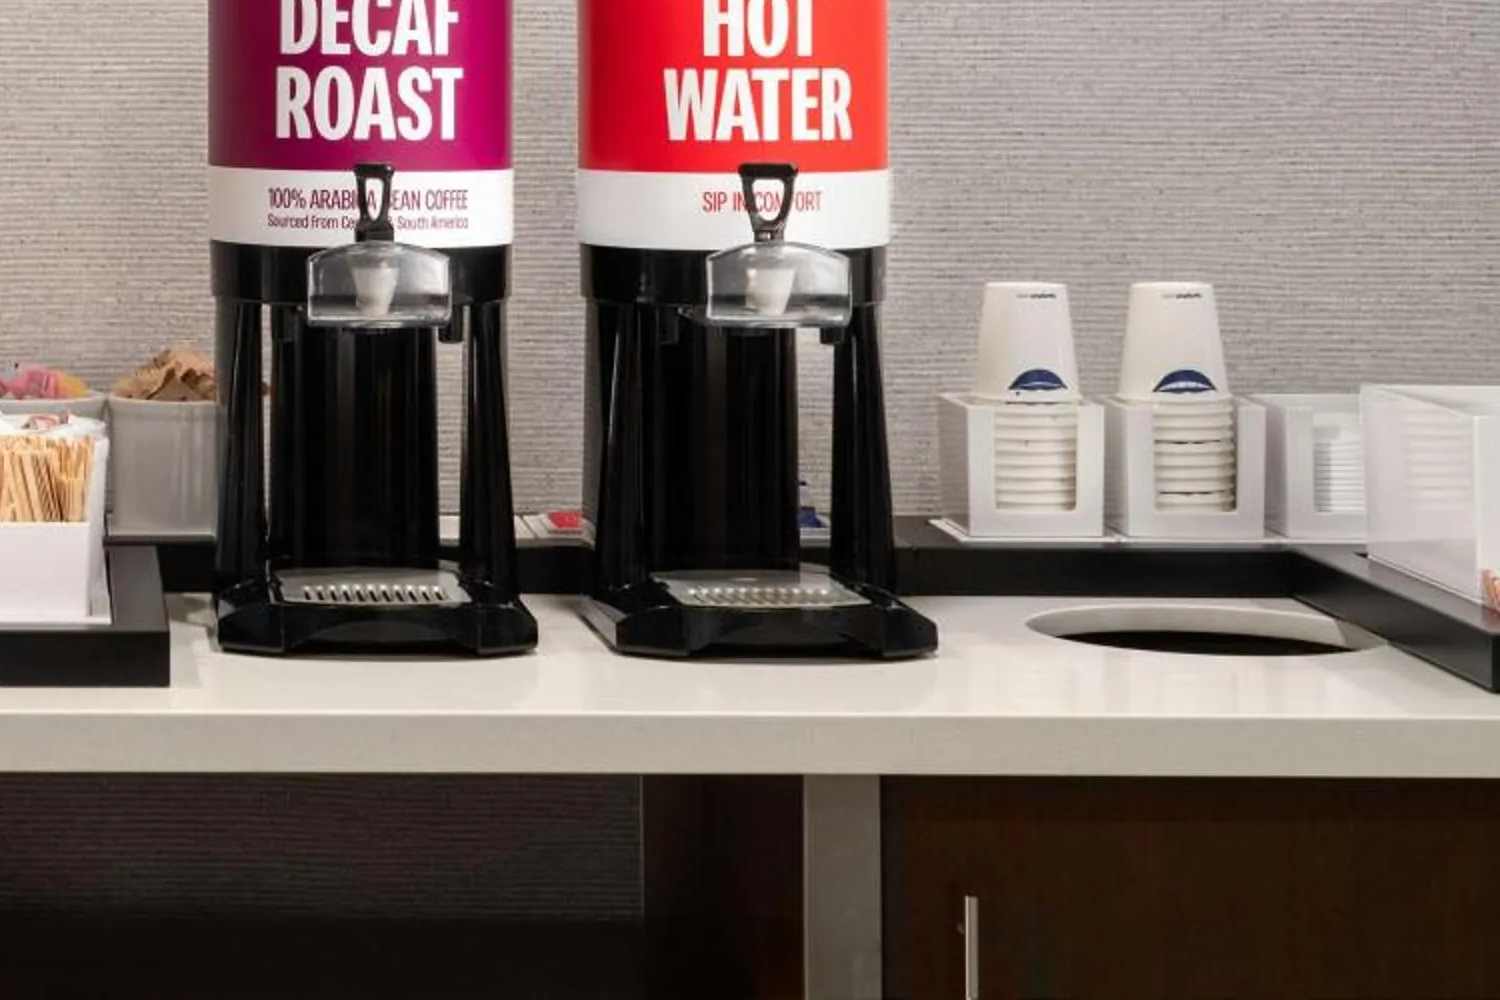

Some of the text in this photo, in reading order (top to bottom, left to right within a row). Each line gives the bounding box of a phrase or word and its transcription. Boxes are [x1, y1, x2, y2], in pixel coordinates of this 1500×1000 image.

[276, 65, 464, 140] ROAST
[663, 67, 853, 142] WATER
[268, 187, 468, 211] 100% ARABIA EAN COFFEE
[702, 191, 728, 212] SIP
[754, 191, 823, 212] COMORT
[267, 213, 308, 229] Sourced
[312, 214, 338, 229] From
[397, 215, 428, 229] South
